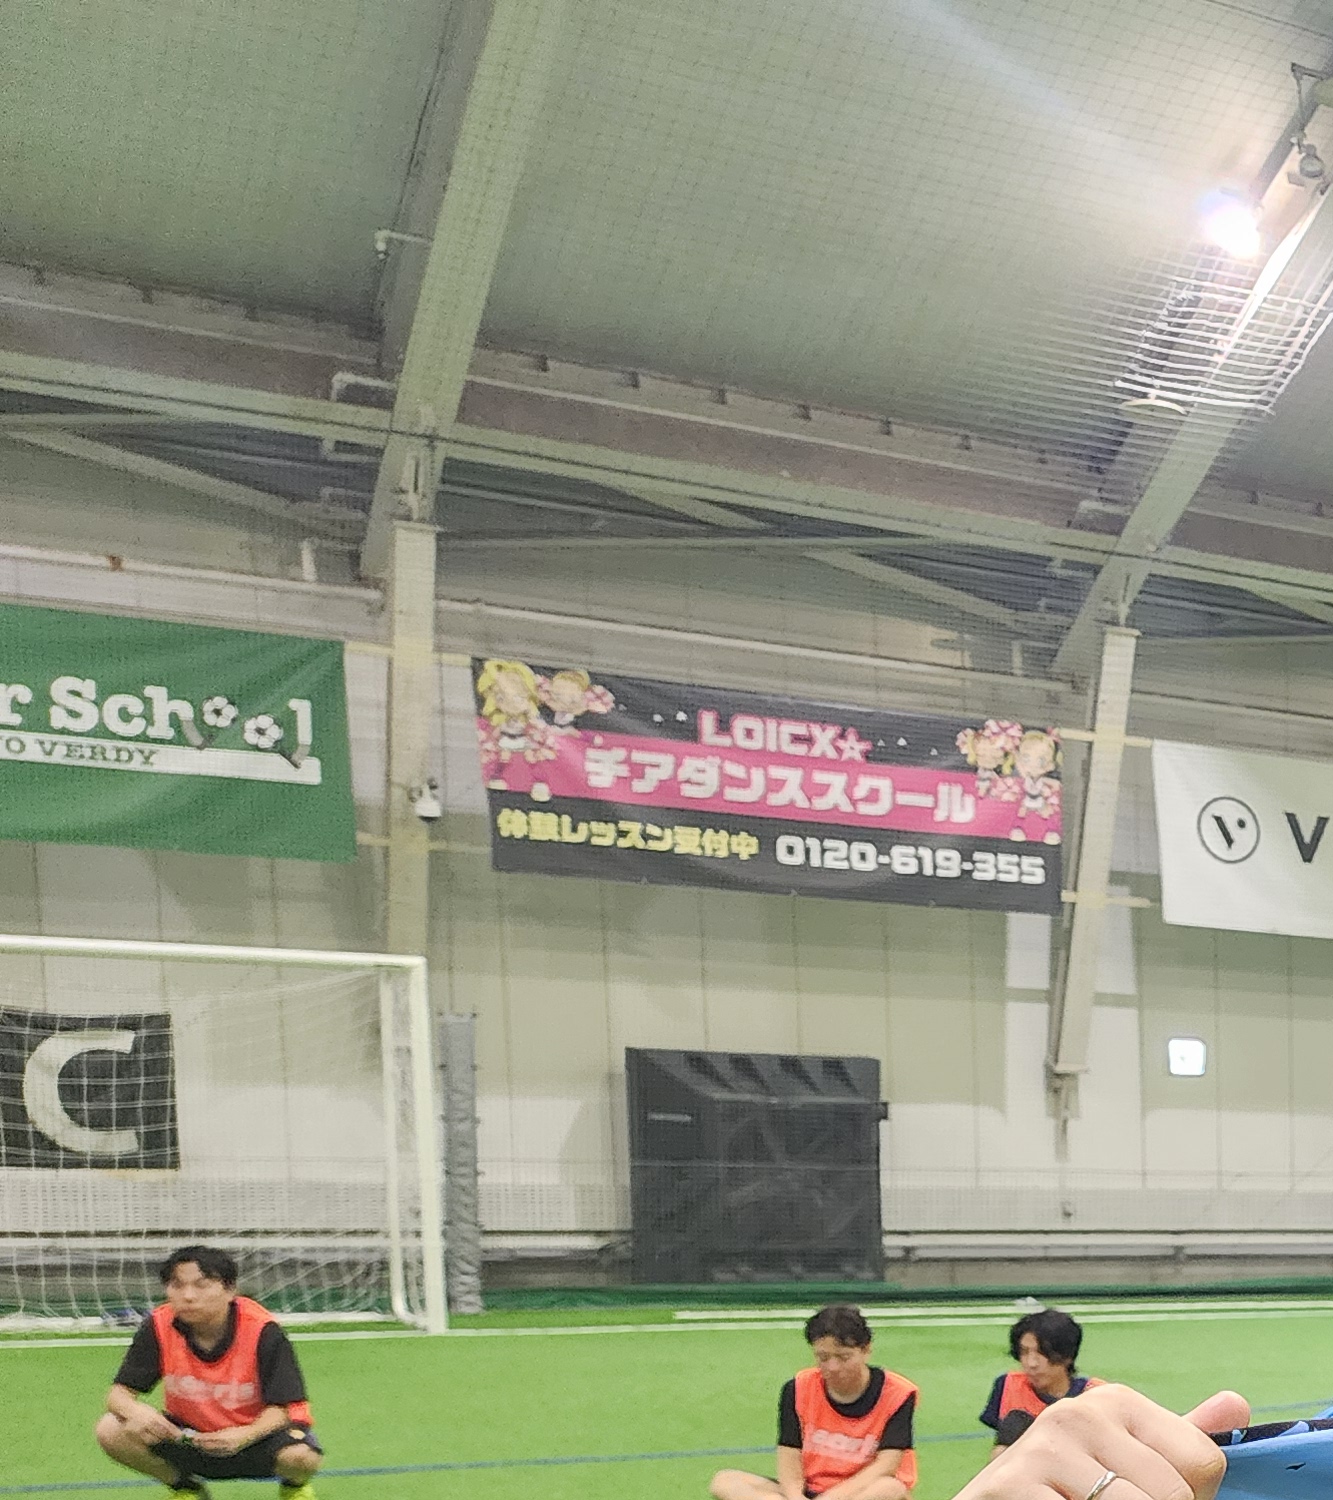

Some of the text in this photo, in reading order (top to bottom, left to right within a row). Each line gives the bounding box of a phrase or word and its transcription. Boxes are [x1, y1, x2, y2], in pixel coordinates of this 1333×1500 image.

[36, 739, 157, 766] VERDY
[583, 746, 977, 824] チアダンススクール
[774, 834, 1047, 885] 0120-619-355
[23, 1029, 139, 1158] C
